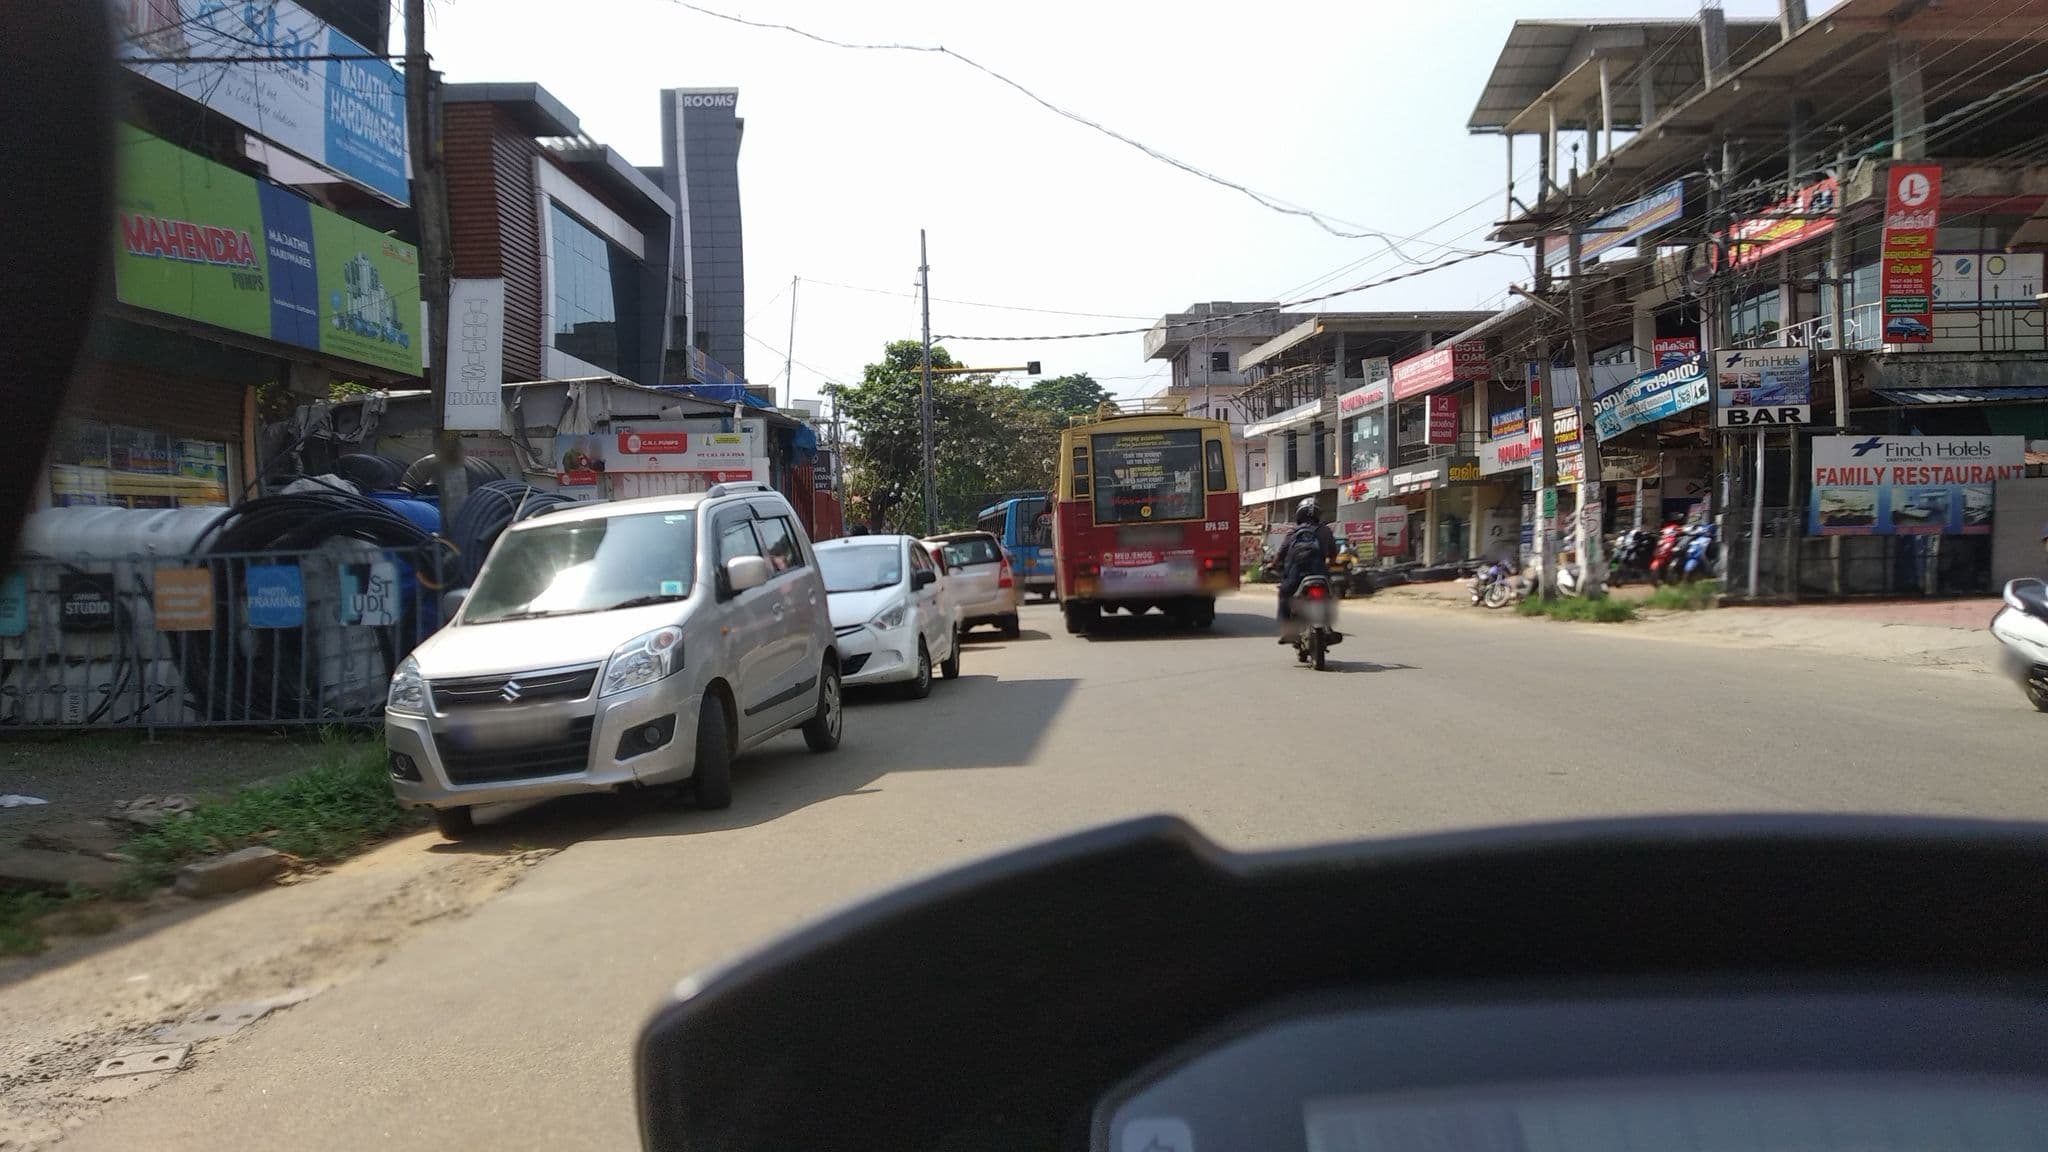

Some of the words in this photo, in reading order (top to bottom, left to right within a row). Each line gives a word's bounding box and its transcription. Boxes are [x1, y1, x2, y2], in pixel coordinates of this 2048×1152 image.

[684, 95, 734, 107] ROOMS
[330, 87, 404, 158] HARDWARES
[1908, 178, 1922, 197] L
[120, 214, 259, 267] MAHENDRA
[231, 272, 264, 291] PUMPS
[1456, 353, 1486, 362] LOAN
[1744, 356, 1768, 367] Finch
[448, 392, 497, 406] HOME
[1727, 408, 1801, 425] BAR
[1886, 441, 1931, 457] Finch
[1937, 440, 1991, 456] Hotels
[1816, 467, 1886, 486] FAMILY
[1893, 464, 2024, 485] RESTAURANT
[65, 601, 111, 616] STUDIO
[248, 596, 301, 608] FRAMING
